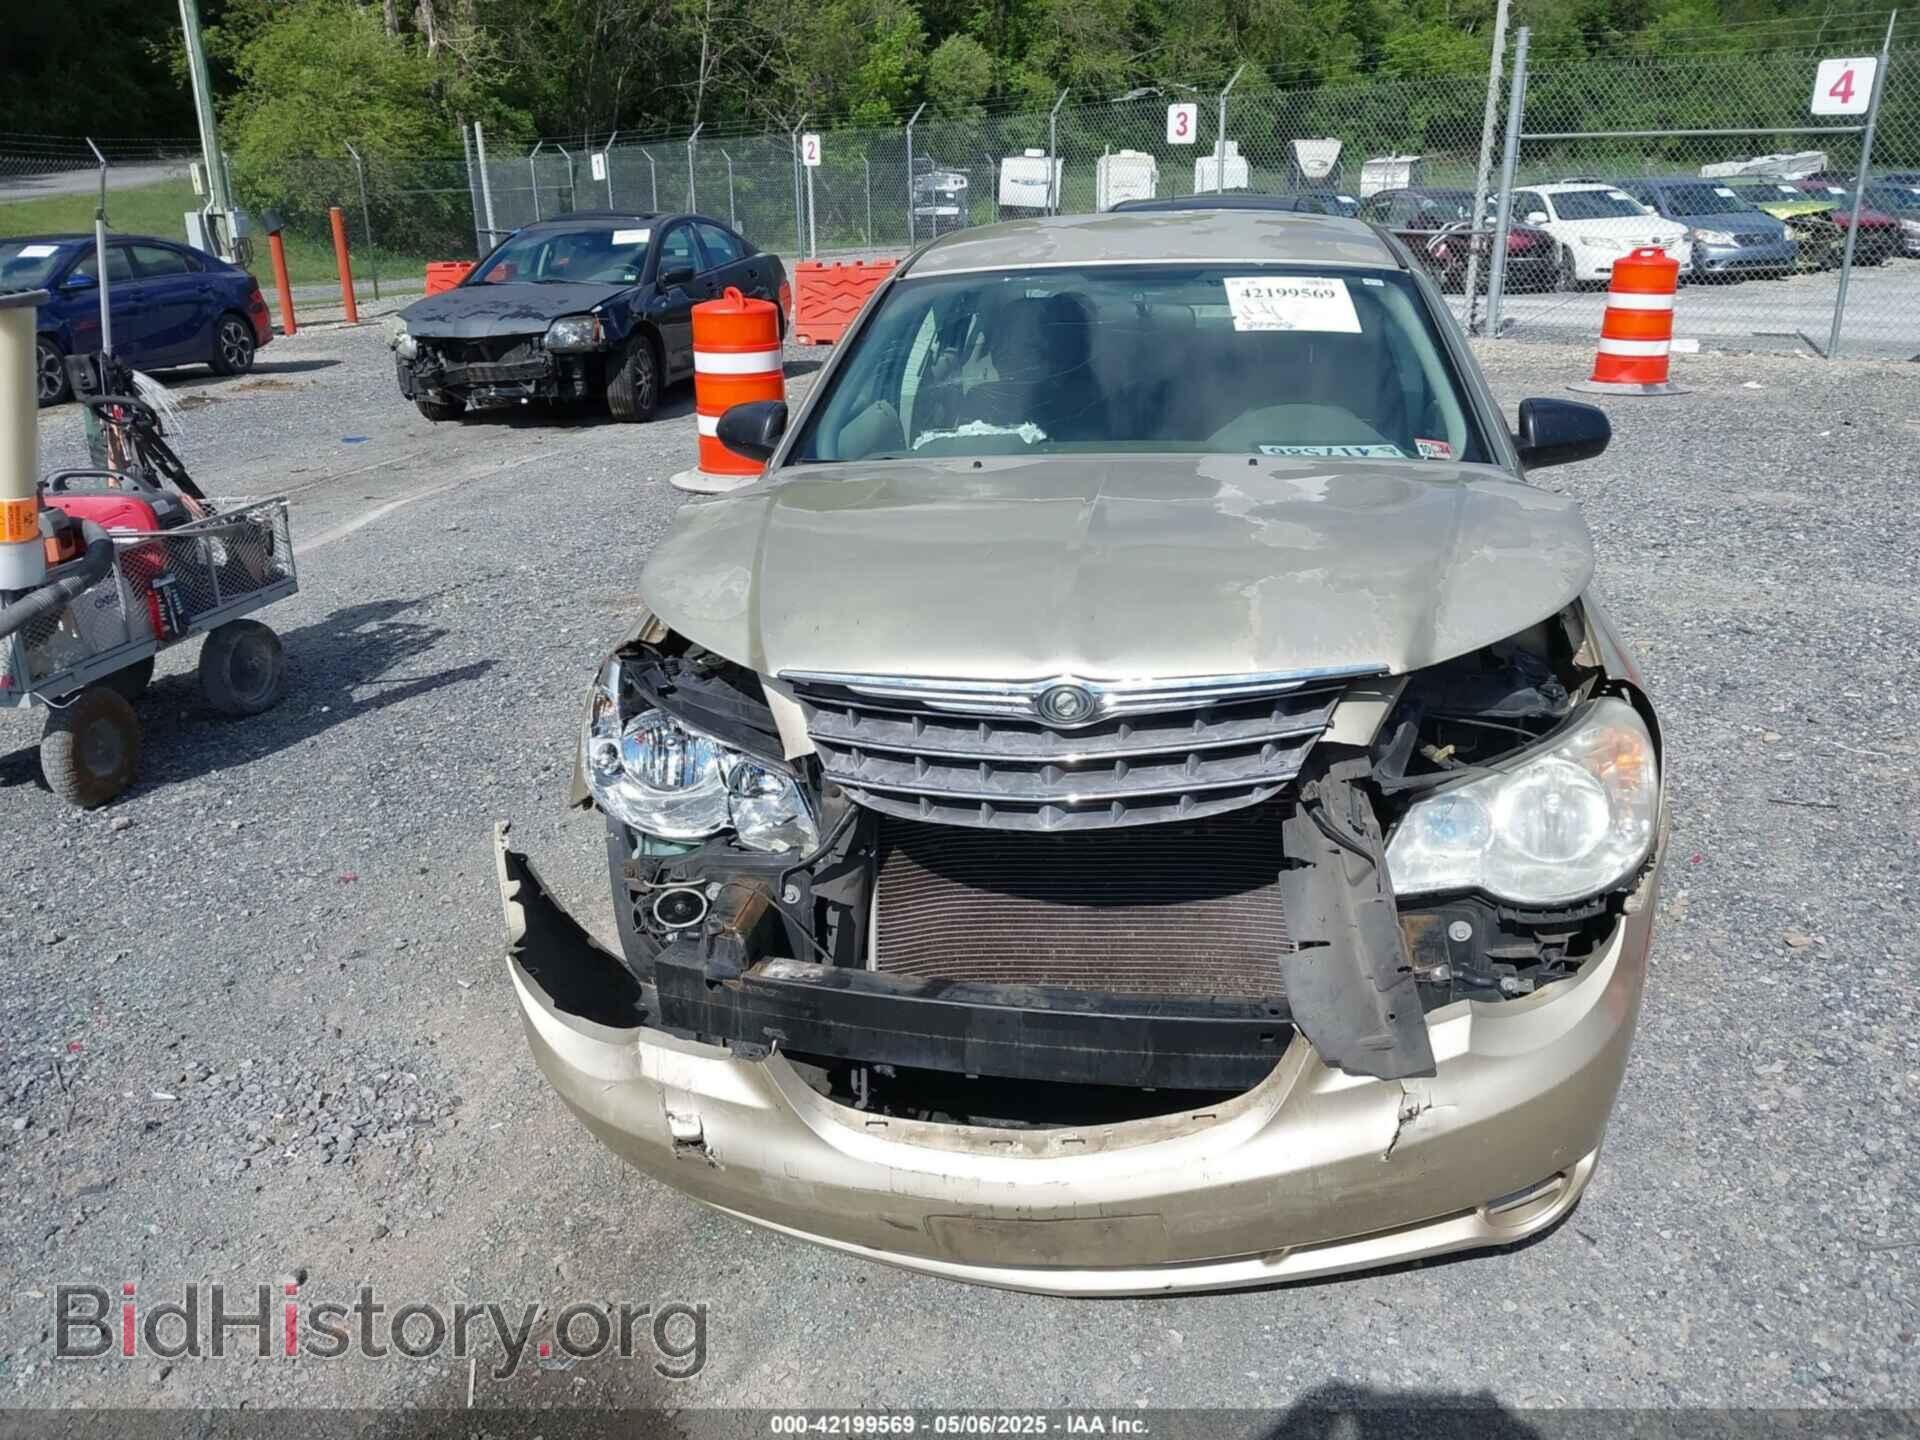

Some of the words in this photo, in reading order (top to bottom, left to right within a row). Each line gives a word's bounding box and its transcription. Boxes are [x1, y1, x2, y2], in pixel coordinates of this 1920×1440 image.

[1828, 69, 1855, 104] 4
[1175, 110, 1189, 136] 3
[807, 141, 816, 160] 2
[1240, 287, 1336, 299] 42199569
